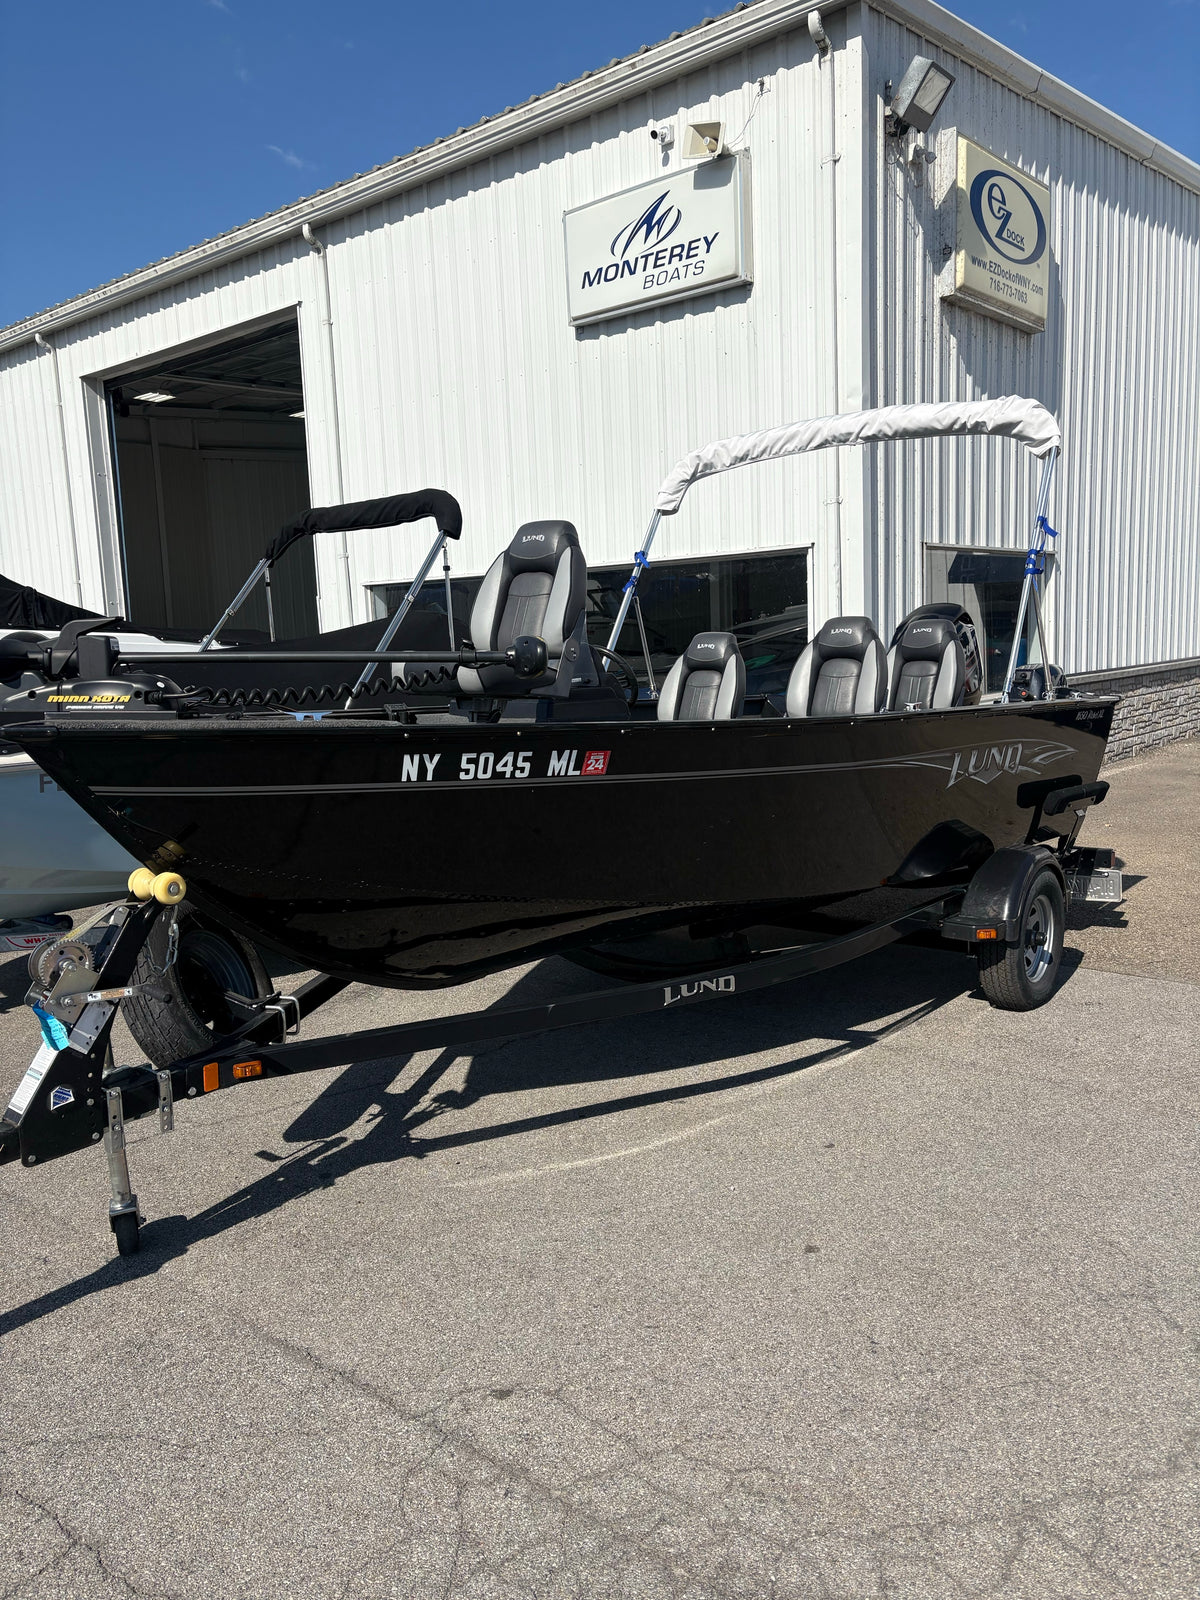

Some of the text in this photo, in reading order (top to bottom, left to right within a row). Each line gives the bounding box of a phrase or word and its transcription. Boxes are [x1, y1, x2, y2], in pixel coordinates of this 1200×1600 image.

[1006, 228, 1025, 246] DOCK
[581, 231, 720, 289] MONTEREY
[643, 259, 705, 289] BOATS
[970, 254, 1044, 296] www.EZDockofWNY.com
[989, 276, 1028, 304] 716-773-7063
[522, 534, 545, 543] LUND
[831, 627, 852, 635] LUND
[91, 695, 131, 703] KOTA
[401, 749, 581, 782] NY 5045 ML
[586, 759, 604, 771] 24
[945, 742, 1023, 790] LUND
[663, 975, 736, 1007] LUND
